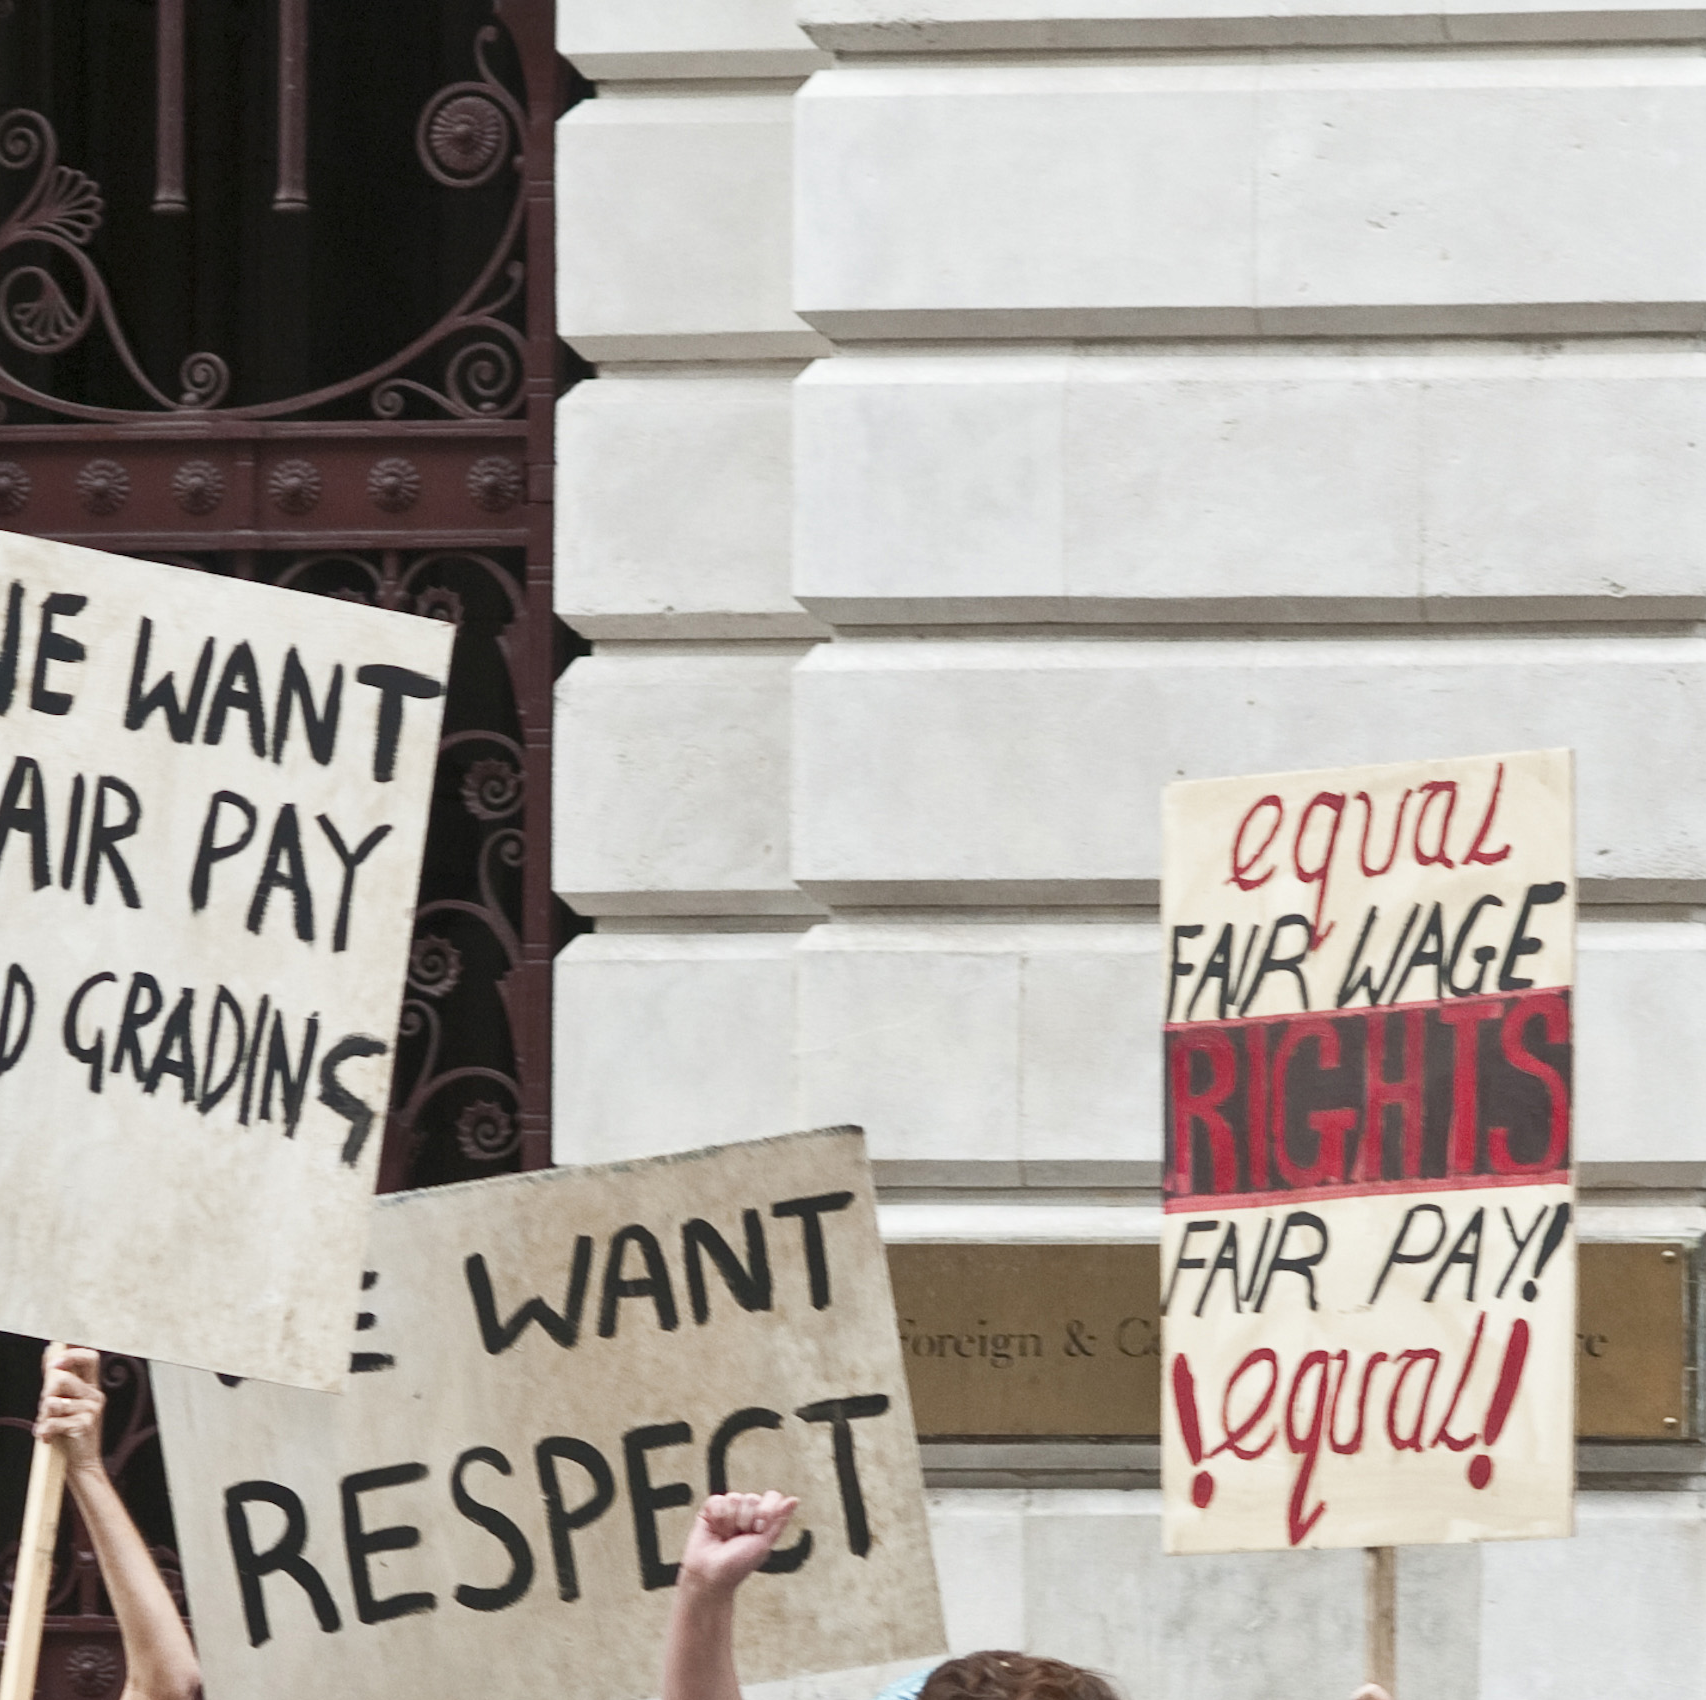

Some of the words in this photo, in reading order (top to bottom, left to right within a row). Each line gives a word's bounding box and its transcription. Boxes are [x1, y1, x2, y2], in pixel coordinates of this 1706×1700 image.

[124, 616, 448, 783] WANT
[192, 790, 393, 953] PAY
[1224, 762, 1514, 950] equal
[1165, 912, 1314, 1023] FAIR
[1335, 880, 1568, 1009] WAGE
[1167, 1001, 1571, 1198] RIGHTS
[464, 1191, 855, 1357] WANT
[1161, 1210, 1330, 1318] FAIR
[1368, 1201, 1573, 1307] PAY!
[899, 1318, 1043, 1370] oreign
[1062, 1318, 1098, 1358] &
[223, 1393, 892, 1650] RESPECT
